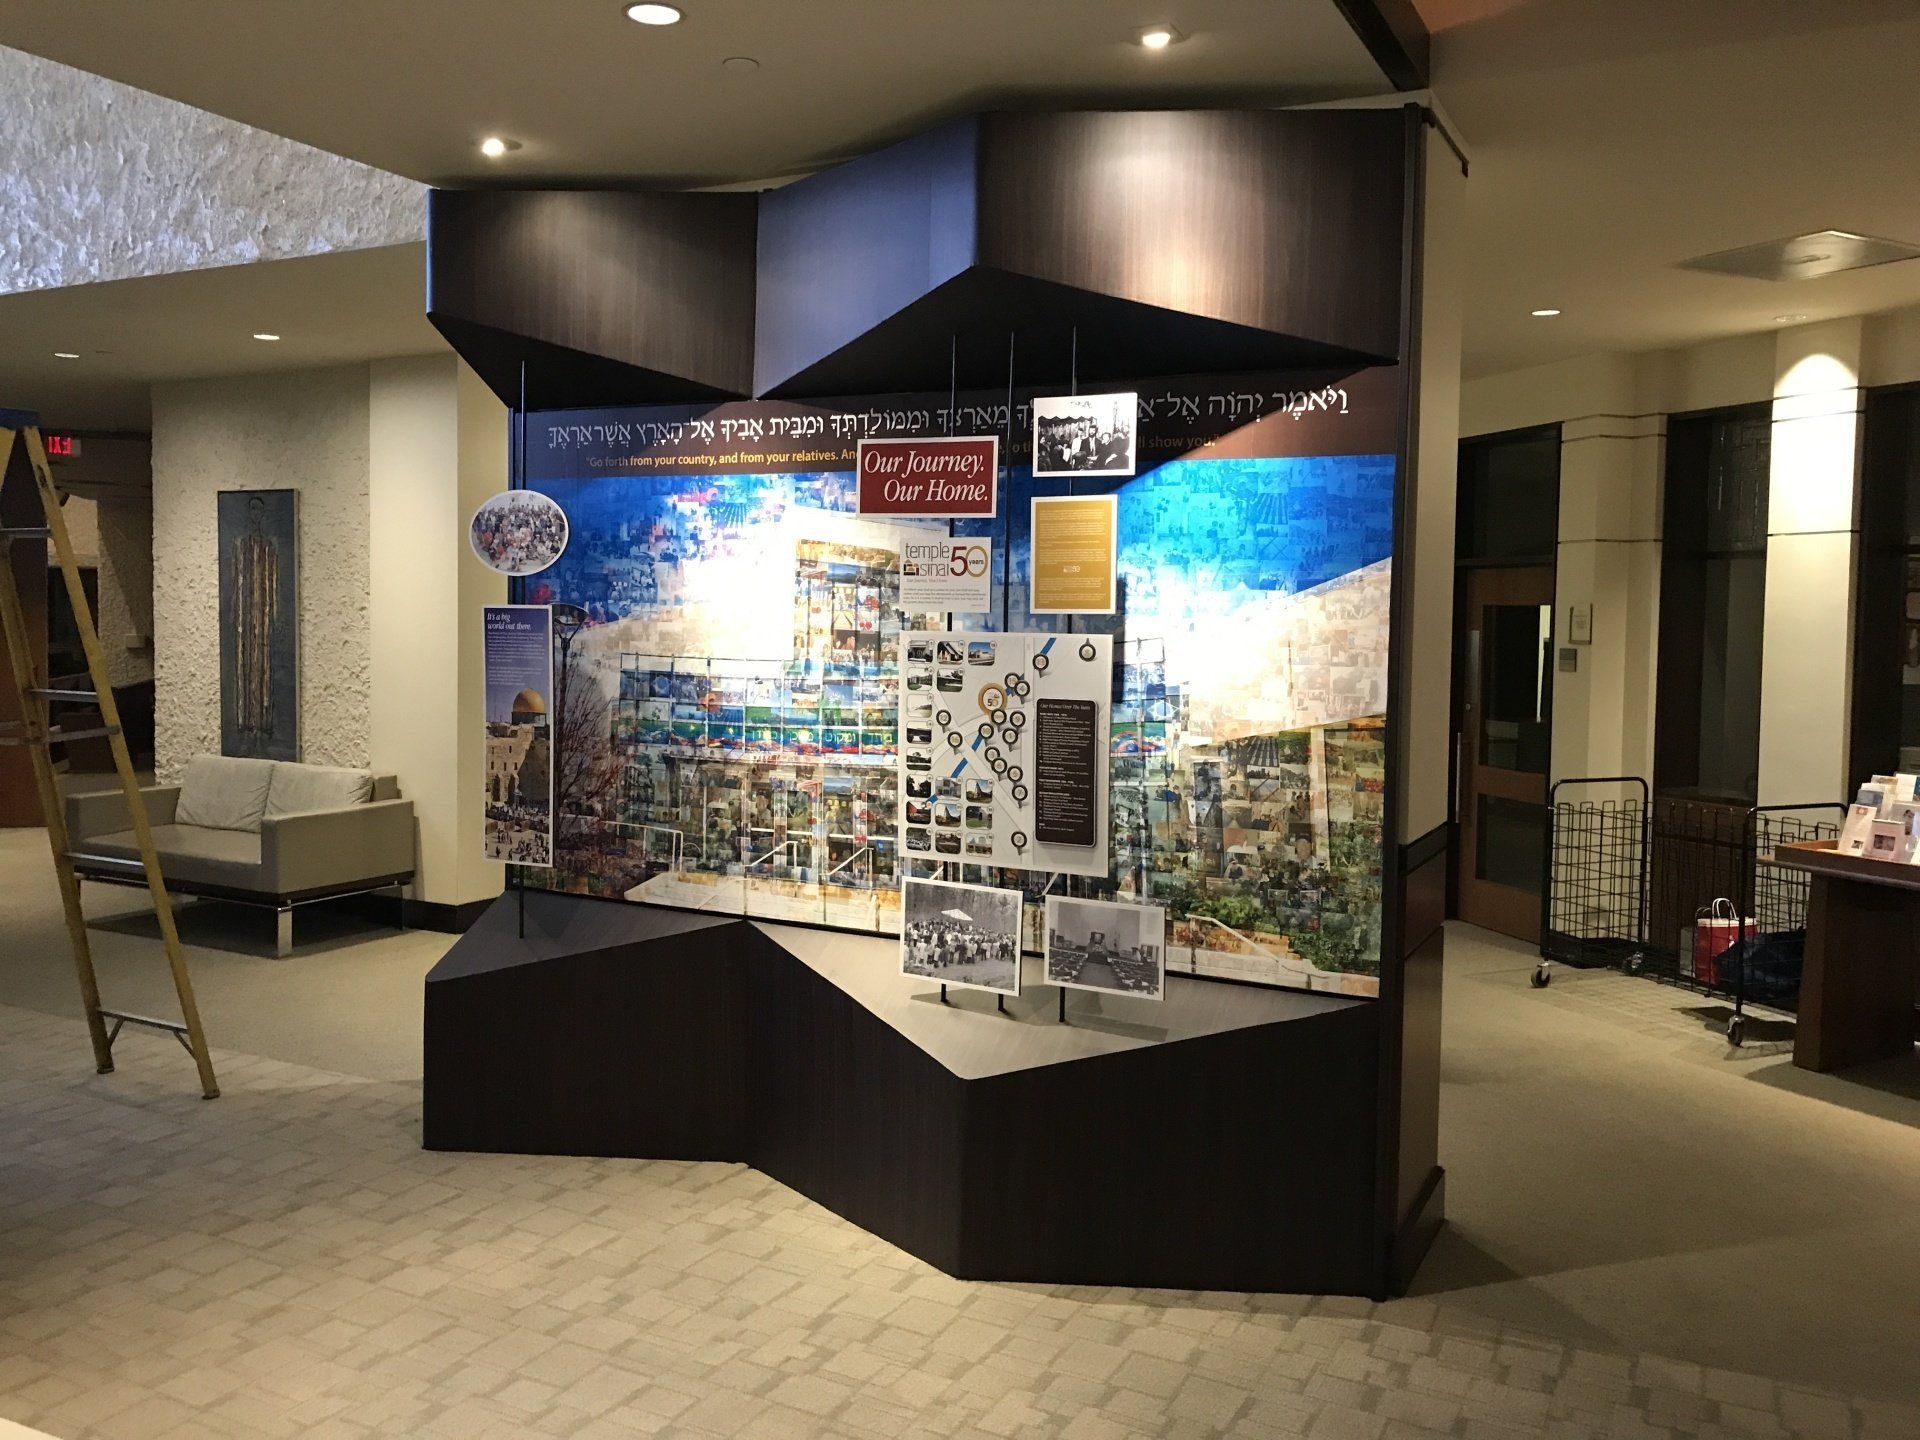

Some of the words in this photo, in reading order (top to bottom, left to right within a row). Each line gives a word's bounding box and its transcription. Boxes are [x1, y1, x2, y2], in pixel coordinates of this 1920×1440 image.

[605, 456, 628, 467] forth
[630, 455, 653, 466] from
[654, 456, 677, 468] your
[677, 453, 717, 467] country,
[719, 452, 739, 464] and
[740, 451, 764, 463] from
[766, 452, 790, 465] your
[792, 449, 839, 462] relatives.
[1148, 434, 1184, 448] show
[864, 450, 904, 474] Our
[901, 450, 985, 479] Journey.
[884, 479, 923, 502] Our
[925, 479, 988, 502] Home.
[905, 541, 950, 562] temple
[950, 545, 988, 577] 50
[919, 563, 950, 577] sinai
[487, 612, 495, 621] It's
[501, 612, 511, 623] big
[487, 622, 505, 630] world
